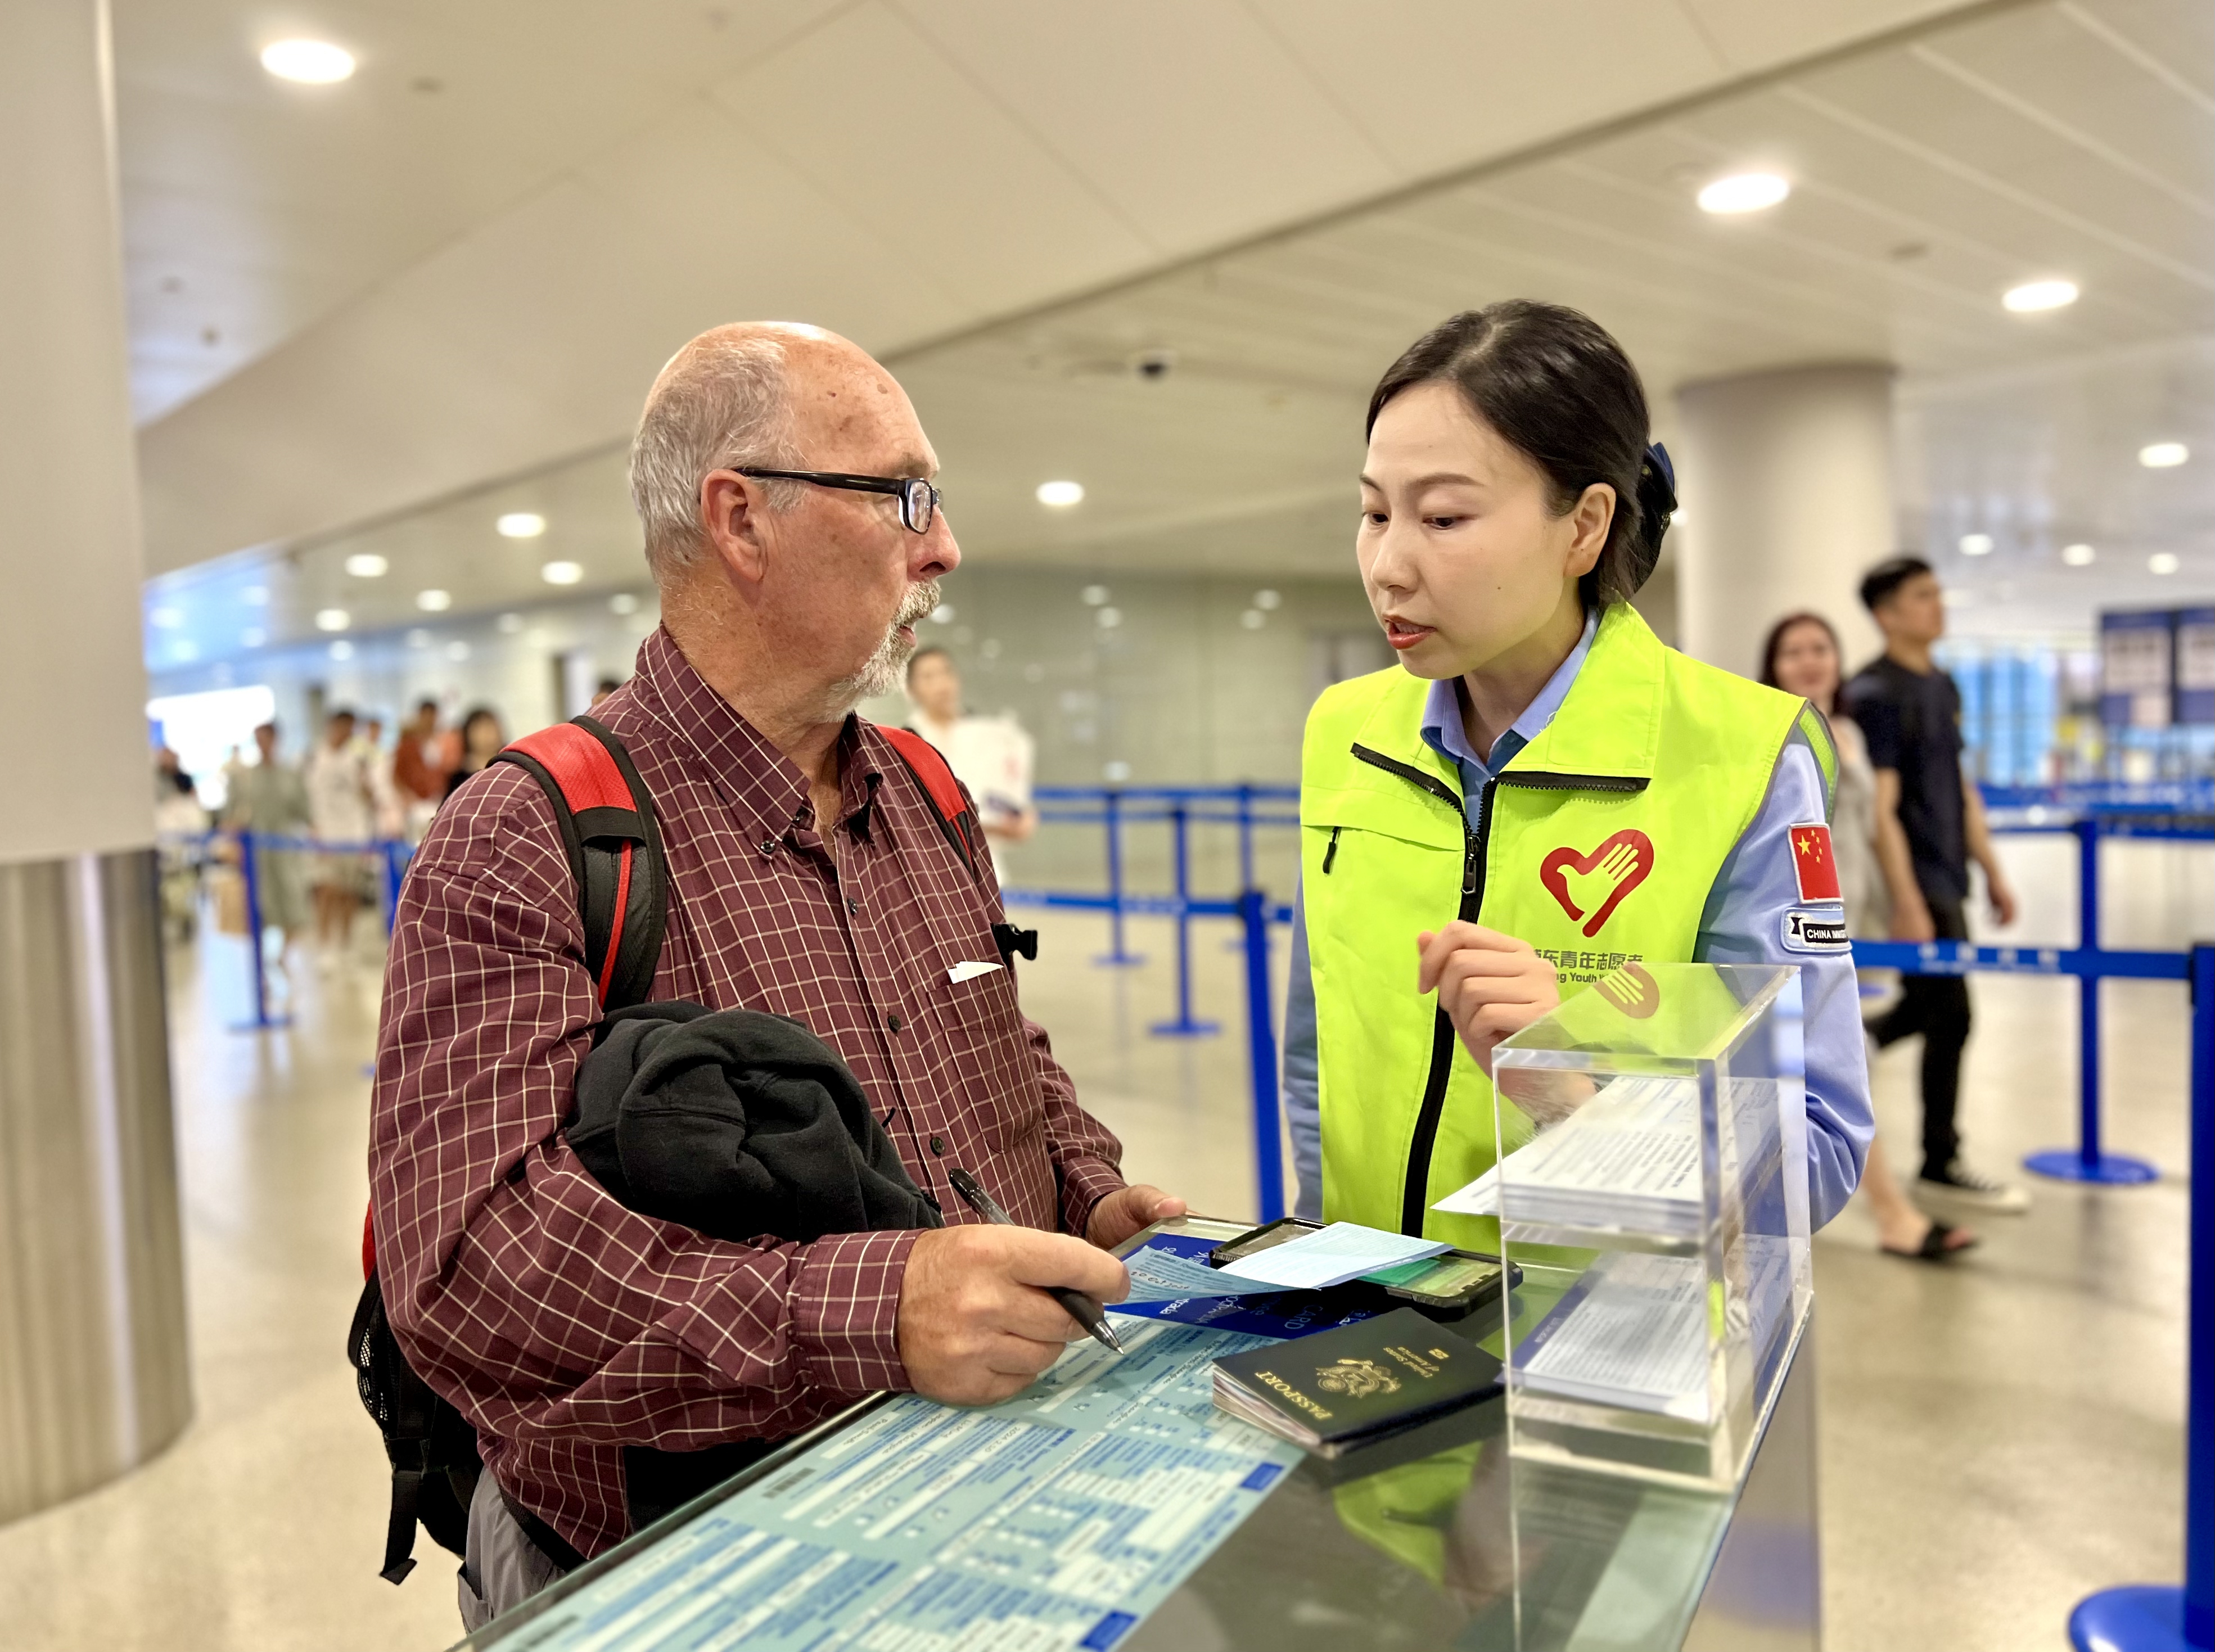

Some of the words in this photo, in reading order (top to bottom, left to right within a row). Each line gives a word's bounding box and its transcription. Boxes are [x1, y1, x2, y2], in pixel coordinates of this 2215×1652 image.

[1807, 929, 1831, 939] CHINA
[1569, 972, 1596, 982] Youth
[1284, 1305, 1324, 1330] CARD
[1254, 1371, 1333, 1420] PASSPORT
